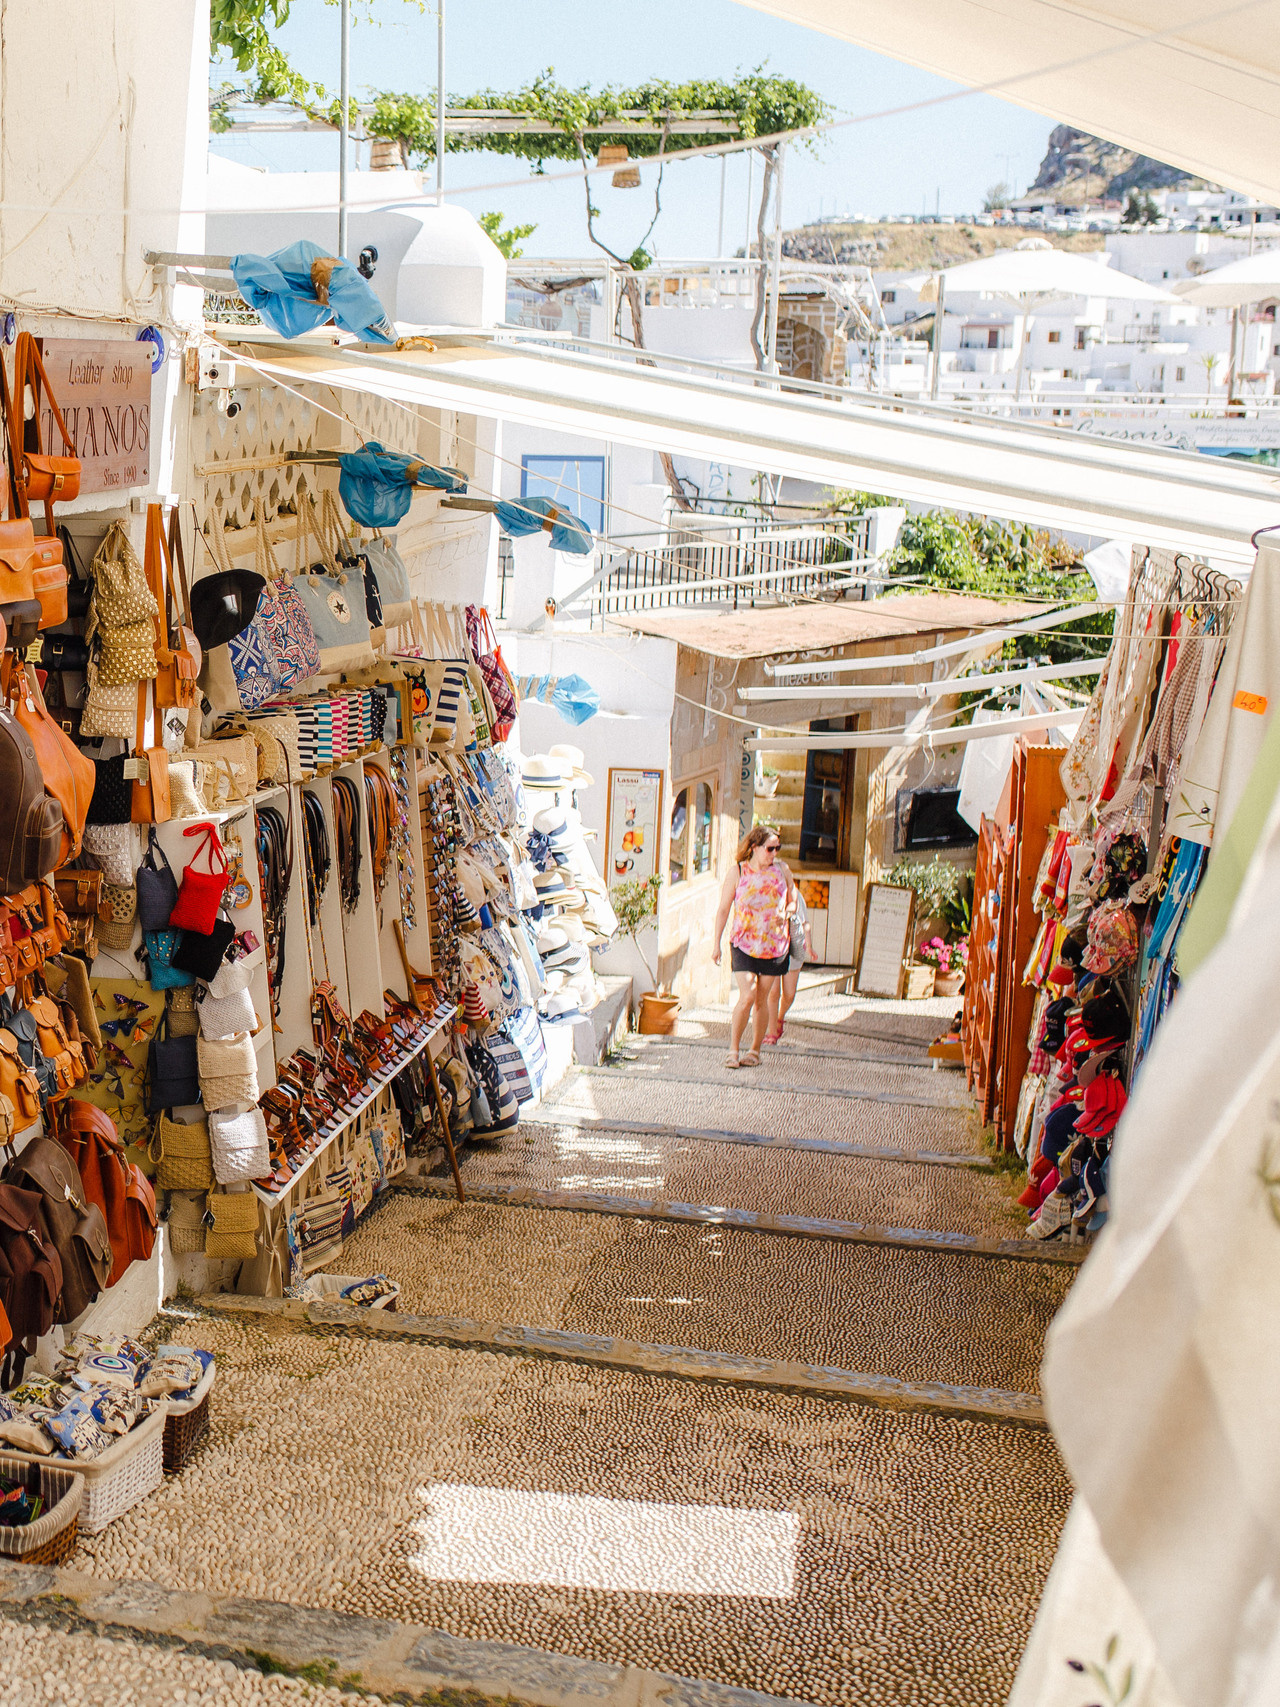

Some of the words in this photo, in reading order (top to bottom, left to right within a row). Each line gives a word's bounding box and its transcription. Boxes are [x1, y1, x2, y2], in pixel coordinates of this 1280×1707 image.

[68, 359, 104, 385] Leather
[111, 359, 133, 389] shop
[42, 403, 149, 458] THANOS
[103, 467, 119, 486] Since
[123, 465, 137, 484] 1990
